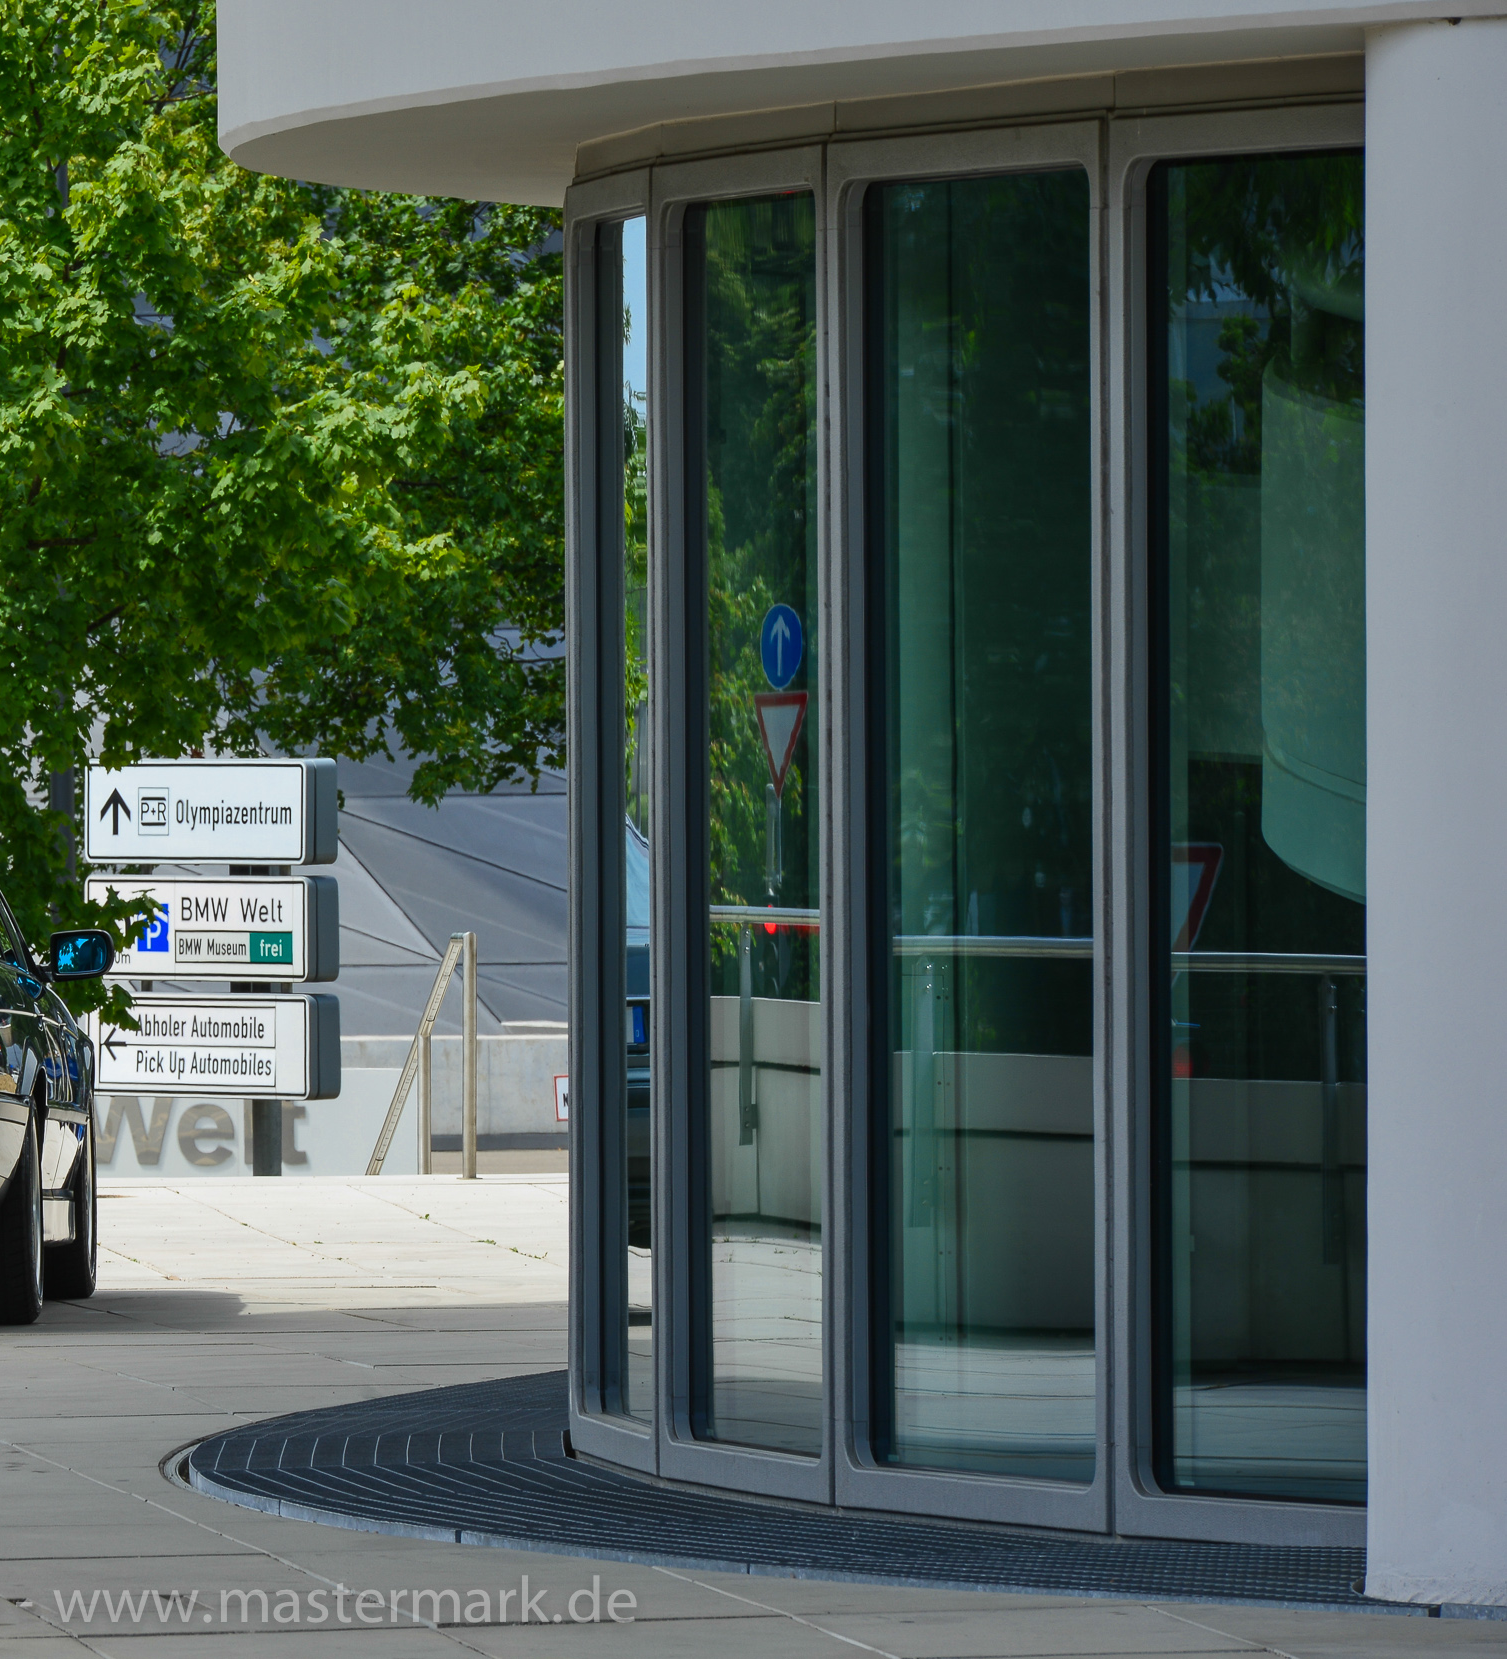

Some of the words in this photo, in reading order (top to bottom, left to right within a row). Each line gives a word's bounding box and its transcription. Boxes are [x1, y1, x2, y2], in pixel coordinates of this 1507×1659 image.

[176, 799, 292, 831] Olympiazentrum
[181, 897, 229, 922] BMW
[240, 897, 283, 923] Welt
[178, 938, 203, 956] BMW
[207, 940, 247, 957] Museum
[260, 939, 283, 958] frei
[135, 1014, 186, 1038] Abholer
[191, 1015, 265, 1040] Automobile
[136, 1050, 164, 1074] Pick
[169, 1053, 186, 1080] Up
[190, 1052, 272, 1076] Automobiles
